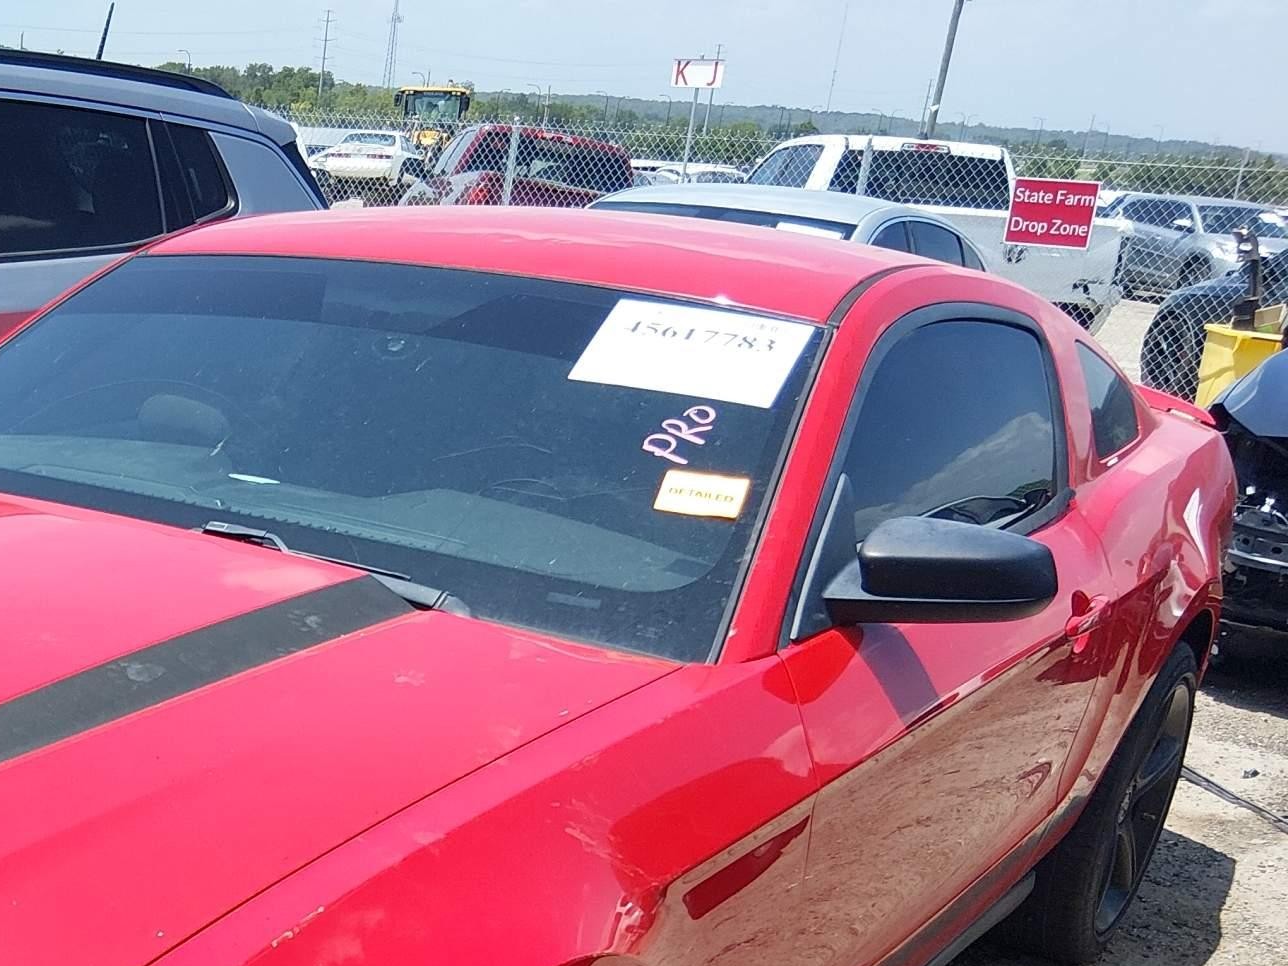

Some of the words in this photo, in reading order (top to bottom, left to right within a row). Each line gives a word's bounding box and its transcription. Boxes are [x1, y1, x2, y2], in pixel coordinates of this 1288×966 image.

[675, 60, 691, 85] K
[706, 61, 718, 86] J
[1015, 188, 1053, 204] State
[1056, 190, 1094, 206] Farm
[1010, 217, 1048, 236] Drop
[1049, 219, 1088, 236] Zone
[624, 320, 776, 353] 45617783
[642, 405, 716, 465] PRO
